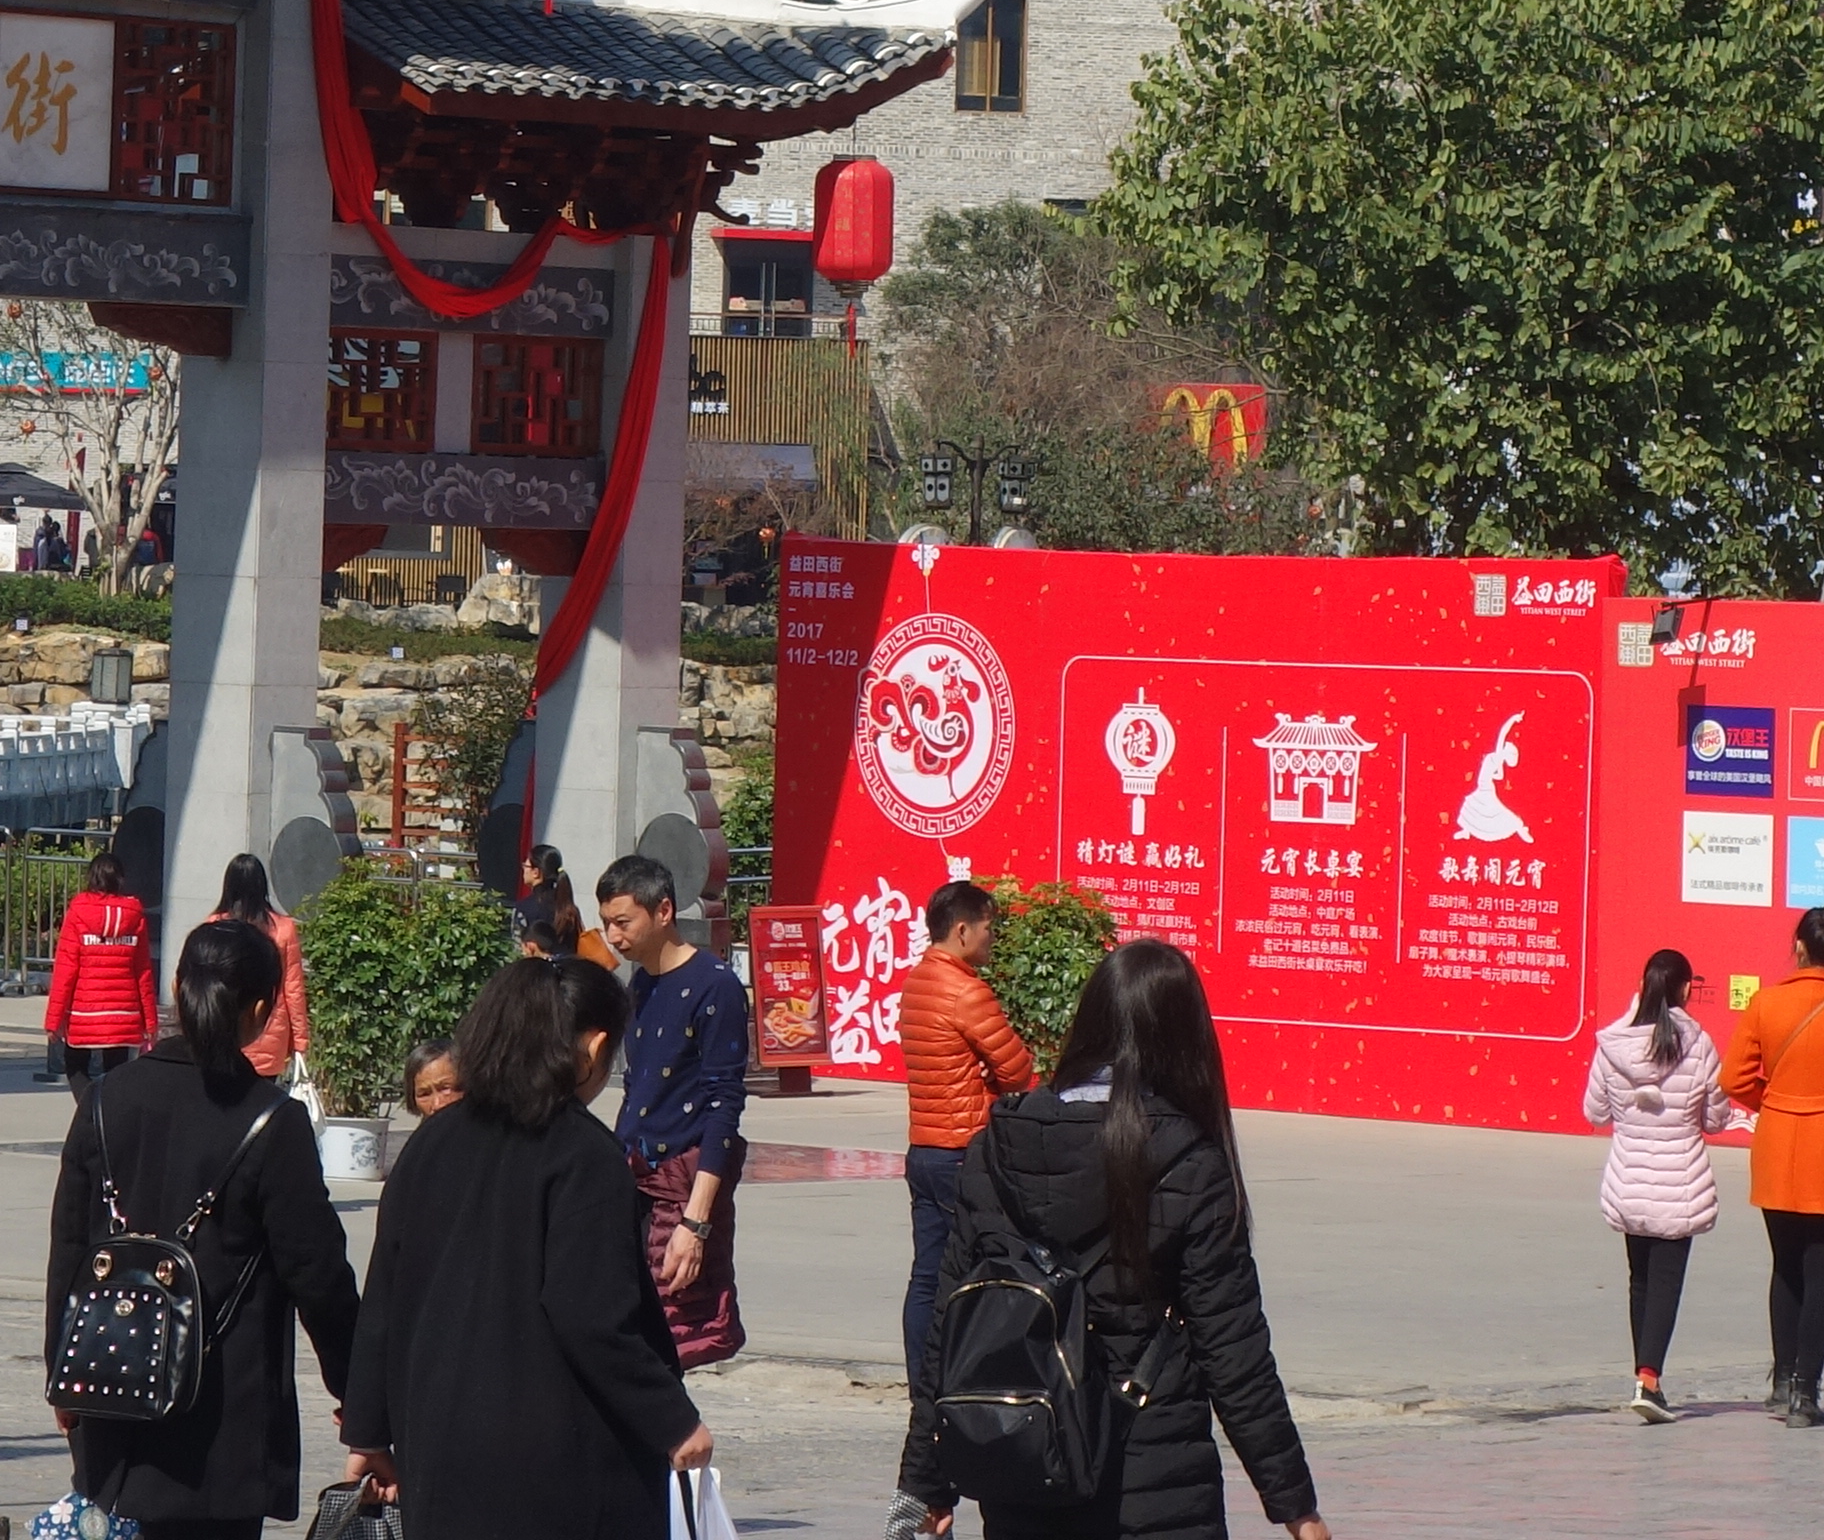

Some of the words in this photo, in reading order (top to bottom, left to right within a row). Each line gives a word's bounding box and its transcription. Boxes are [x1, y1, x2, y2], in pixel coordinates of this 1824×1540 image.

[728, 198, 814, 226] 麦当
[789, 555, 843, 573] 益田西街
[788, 581, 855, 599] 元宵喜乐会
[1511, 575, 1597, 608] 益田西街
[787, 622, 823, 639] 2017
[1726, 728, 1769, 747] 汉堡王
[1077, 837, 1138, 866] 猜灯谜
[1142, 842, 1205, 869] 赢好礼
[1260, 847, 1364, 878] 元宵长桌宴
[1438, 855, 1546, 889] 歌舞闹元宵
